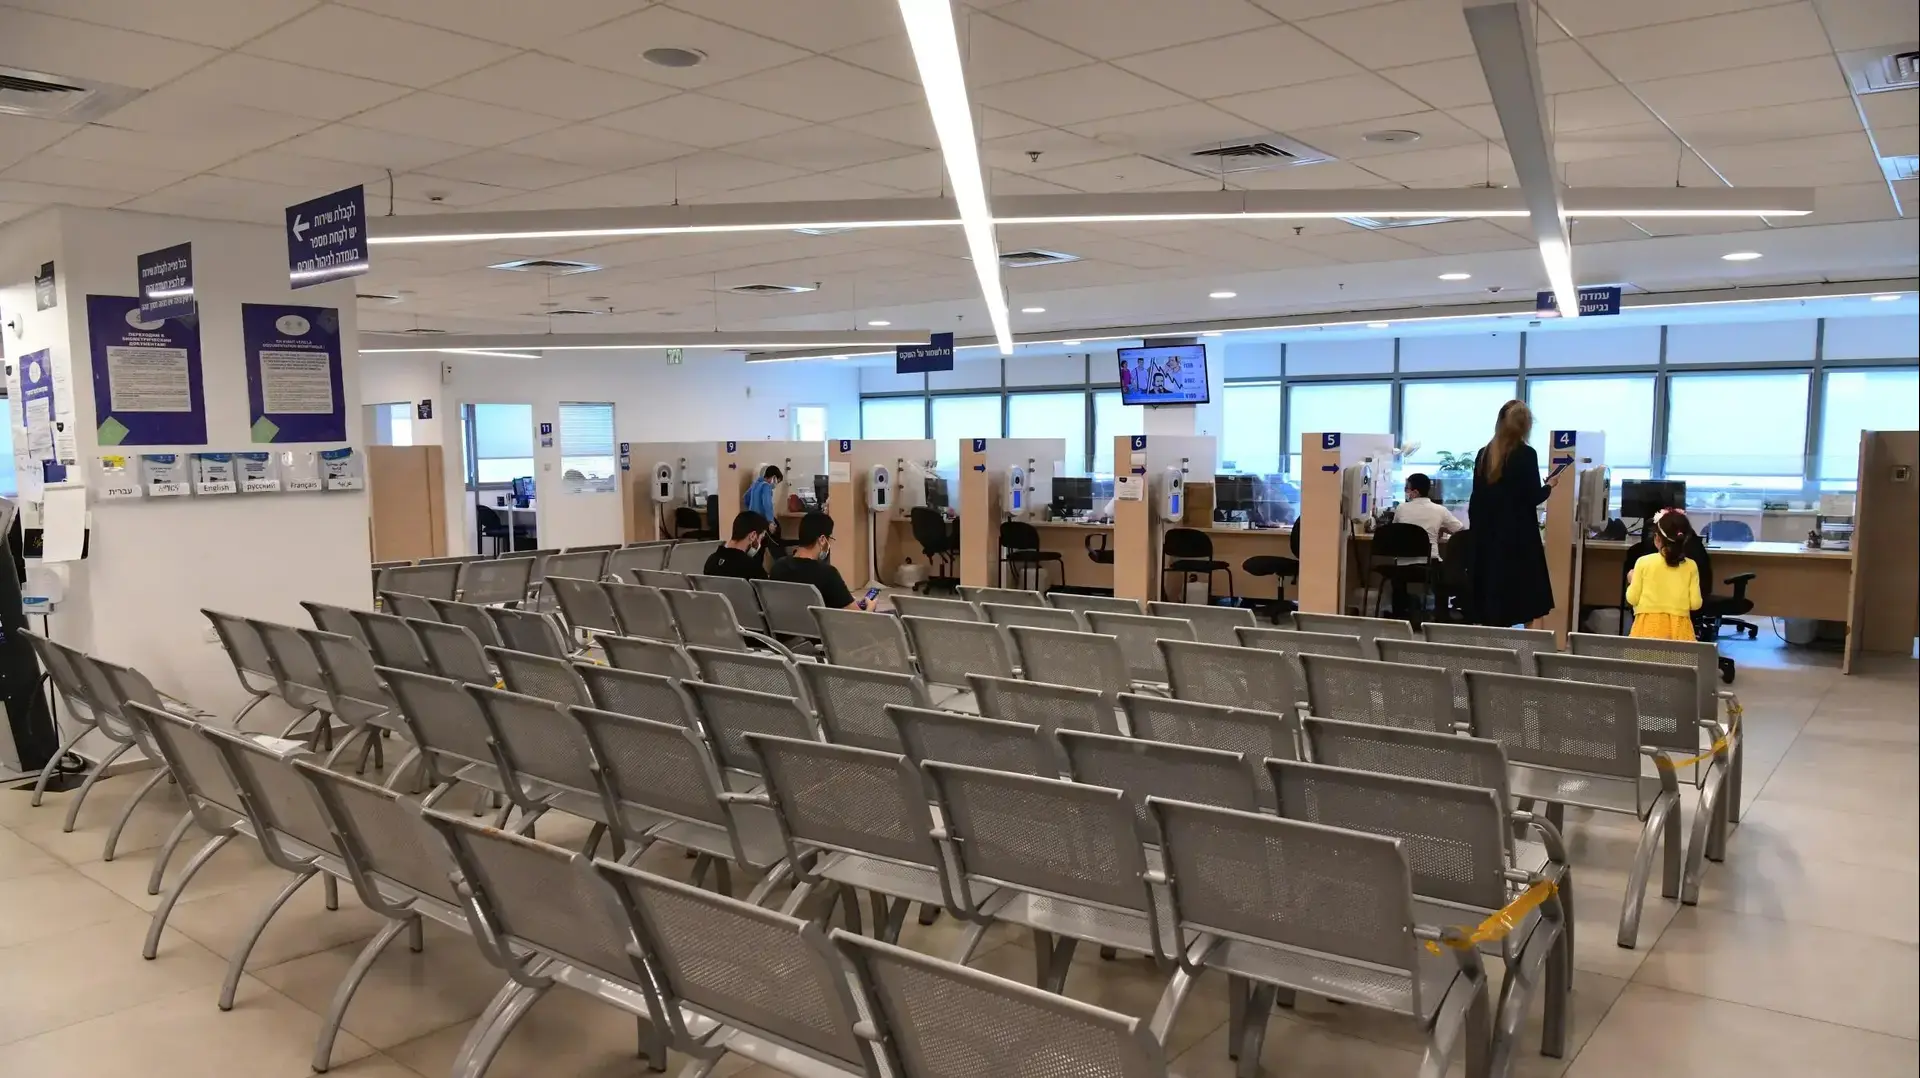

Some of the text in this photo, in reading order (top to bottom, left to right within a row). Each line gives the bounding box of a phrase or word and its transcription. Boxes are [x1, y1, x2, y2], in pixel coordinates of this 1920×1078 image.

[314, 201, 356, 227] לקבלת שירות
[310, 225, 357, 248] יש לקחת מספר
[314, 250, 335, 268] לניהול
[336, 248, 359, 264] בעמדה
[142, 268, 154, 278] שירות
[154, 261, 168, 276] לקבלת
[180, 277, 186, 286] יש
[1580, 292, 1610, 301] עמדת
[1580, 304, 1609, 313] נגישה
[900, 351, 916, 361] השקט
[917, 349, 924, 358] על
[925, 347, 942, 357] לשמור
[542, 424, 550, 433] 11
[1135, 437, 1142, 448] 6
[1327, 434, 1335, 446] 5
[1560, 432, 1570, 445] 4
[621, 443, 629, 452] 10
[728, 442, 734, 451] 9
[842, 441, 848, 450] 8
[976, 440, 983, 449] 7
[203, 484, 230, 493] English
[247, 482, 276, 490] русский
[108, 488, 133, 496] עברית
